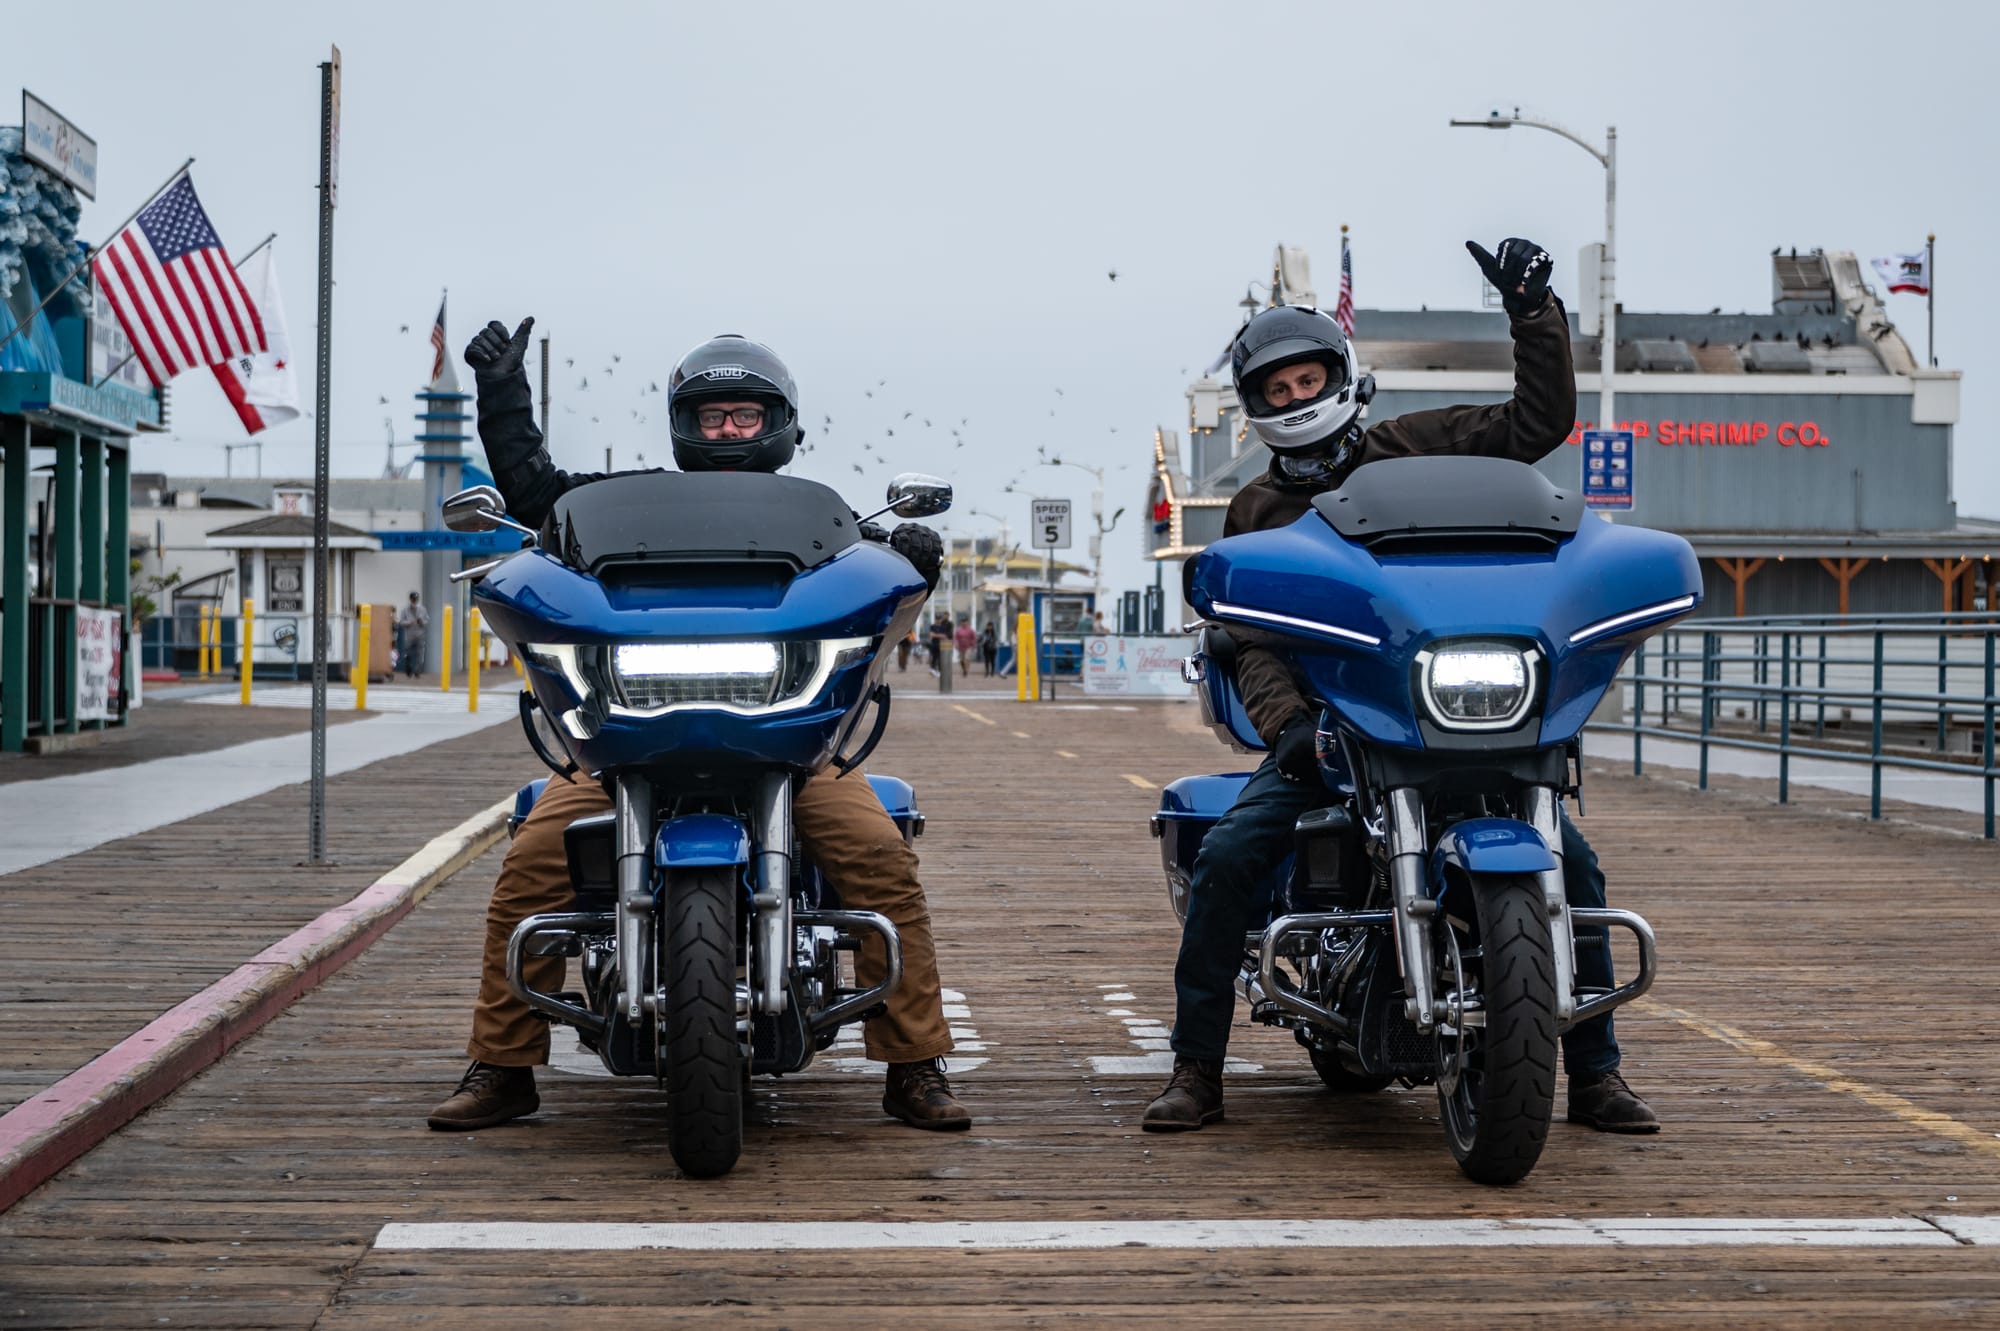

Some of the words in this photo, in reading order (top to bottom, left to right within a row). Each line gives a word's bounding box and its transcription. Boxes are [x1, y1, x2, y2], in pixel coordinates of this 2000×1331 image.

[1658, 421, 1769, 446] SHRIMP
[1777, 422, 1829, 447] CO.
[1036, 505, 1068, 514] SPEED
[1039, 515, 1064, 524] LIMIT
[1045, 525, 1059, 543] 5
